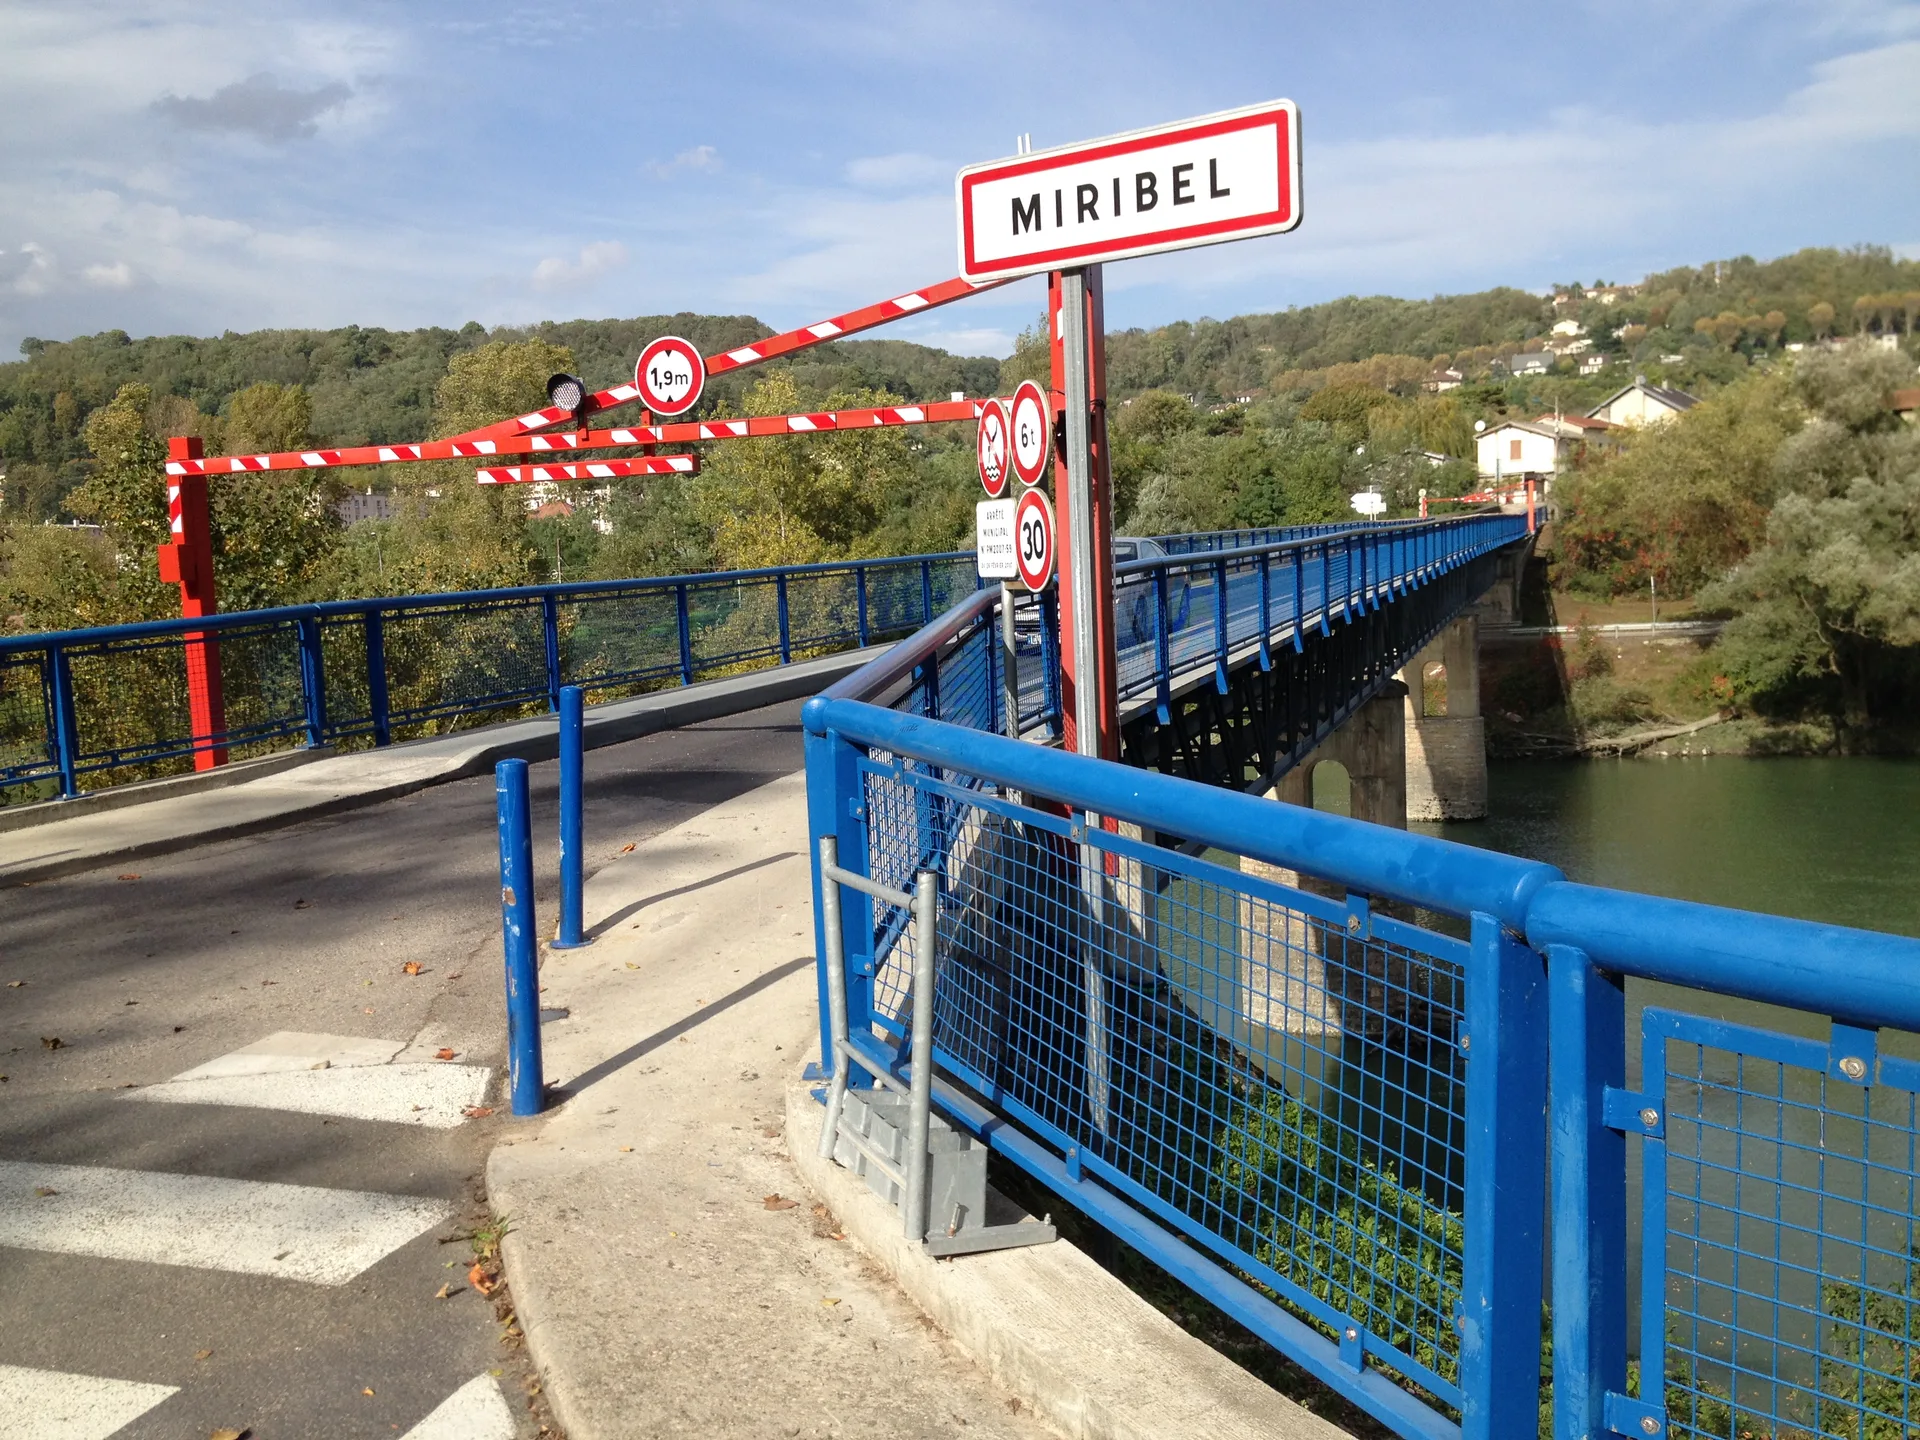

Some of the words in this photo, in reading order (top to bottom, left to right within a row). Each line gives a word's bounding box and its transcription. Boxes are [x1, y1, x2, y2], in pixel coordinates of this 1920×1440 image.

[1011, 157, 1231, 236] MIRIBEL
[650, 367, 689, 390] 1,9m
[982, 527, 1008, 537] MUNICIPAL
[1022, 519, 1045, 562] 30
